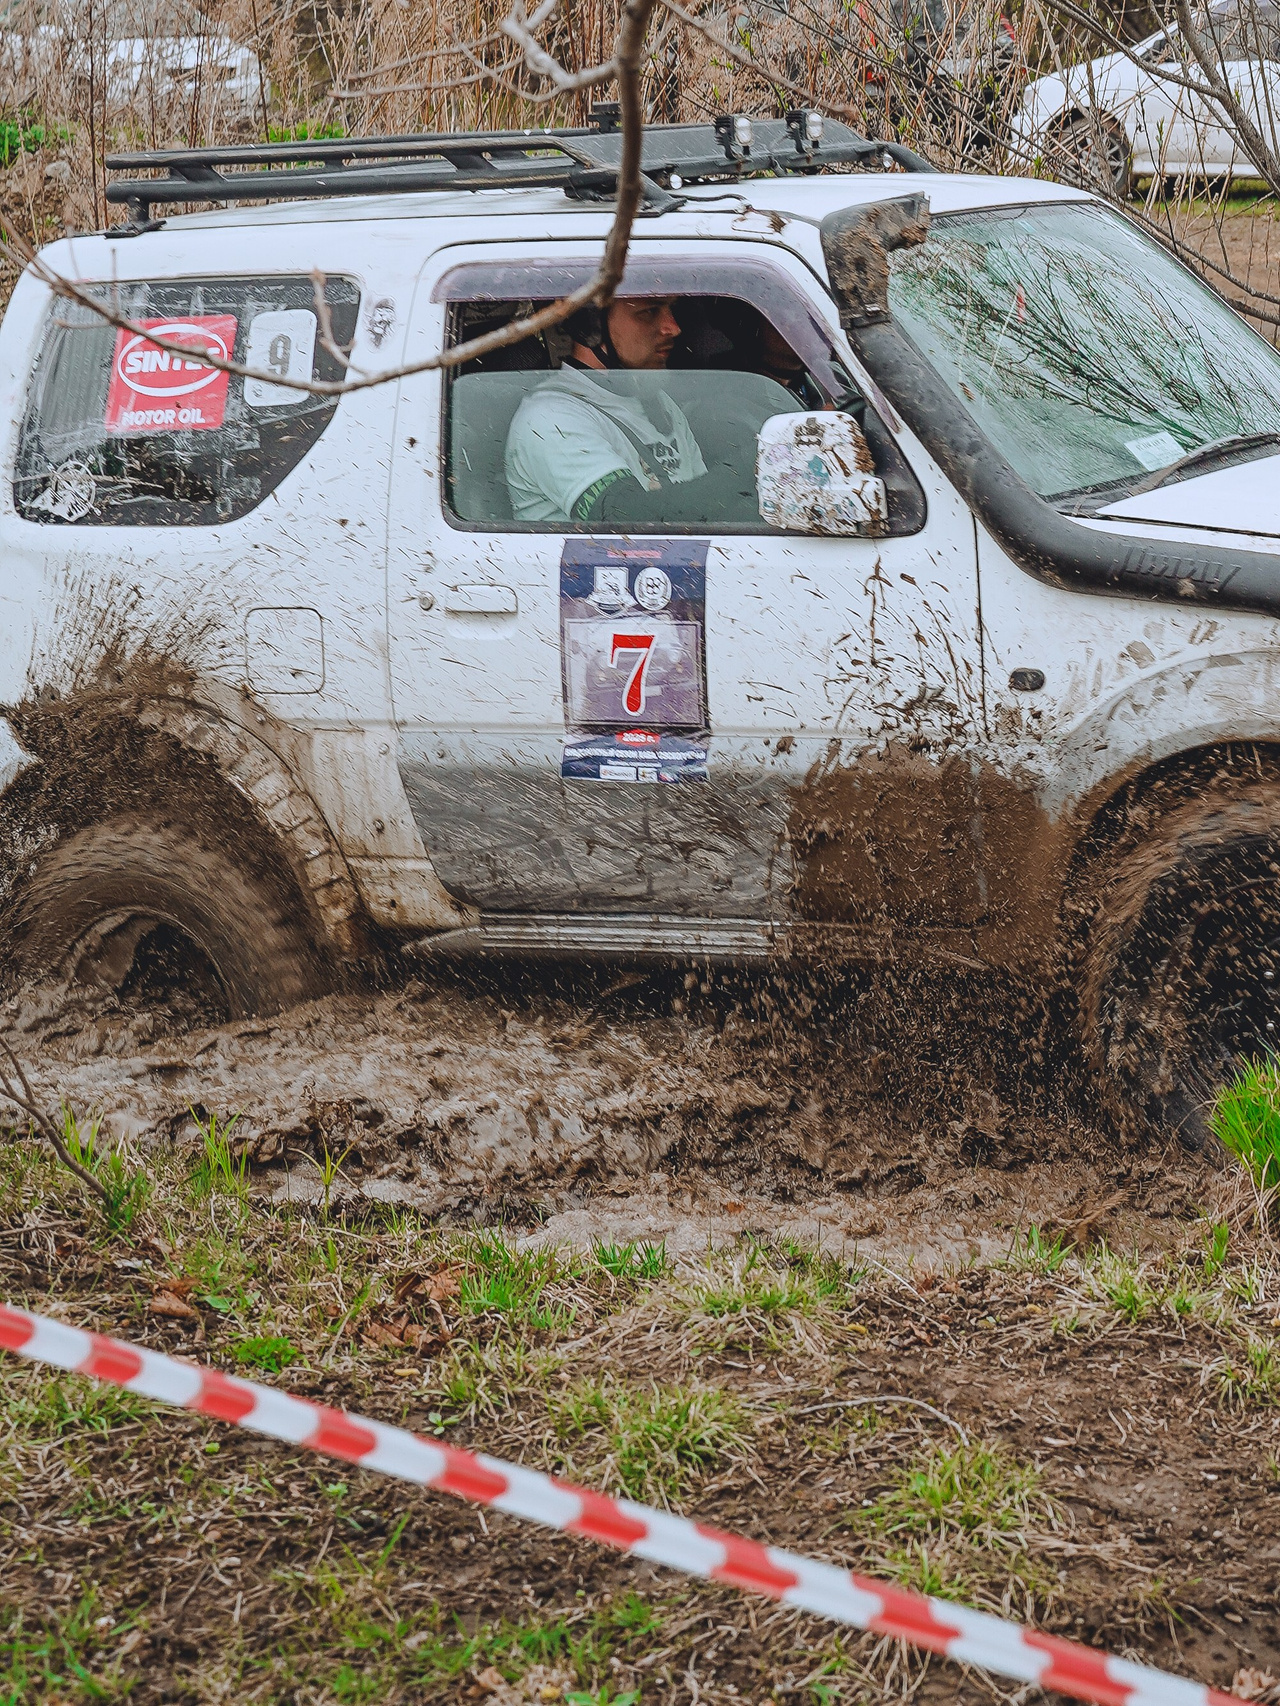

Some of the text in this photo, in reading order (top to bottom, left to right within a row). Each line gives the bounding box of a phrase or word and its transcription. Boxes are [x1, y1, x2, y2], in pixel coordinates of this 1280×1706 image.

[268, 333, 292, 377] 9
[122, 408, 206, 426] MOTOR OIL
[607, 632, 657, 716] 7
